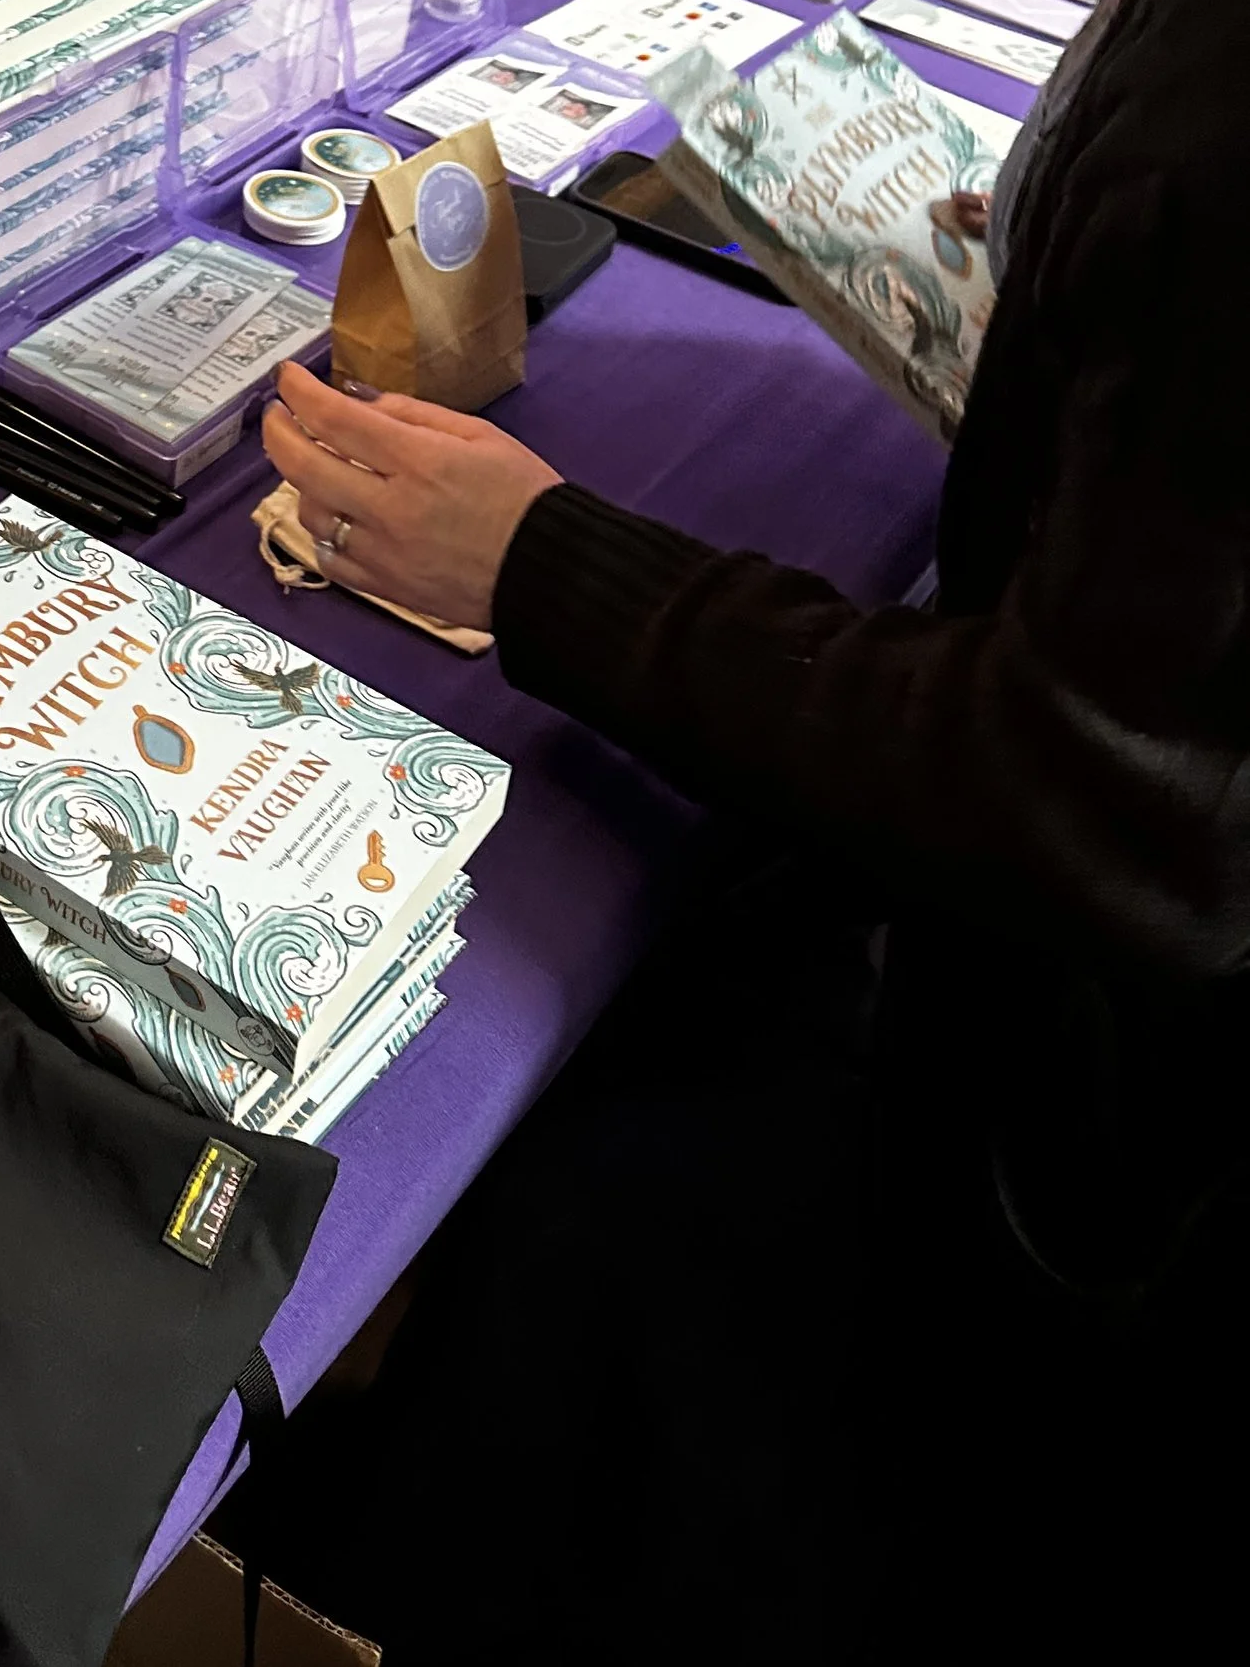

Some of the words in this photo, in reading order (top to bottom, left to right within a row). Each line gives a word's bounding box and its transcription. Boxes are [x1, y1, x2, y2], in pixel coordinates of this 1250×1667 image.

[788, 101, 933, 231] PLYMBURY
[837, 146, 947, 233] WITCH
[190, 738, 290, 835] KENDRA
[217, 749, 332, 862] VAUGHAN
[321, 819, 335, 840] and
[301, 870, 320, 890] JAN
[316, 828, 356, 874] ELIZABETH
[351, 798, 379, 831] WATSON
[40, 886, 109, 945] WITCH
